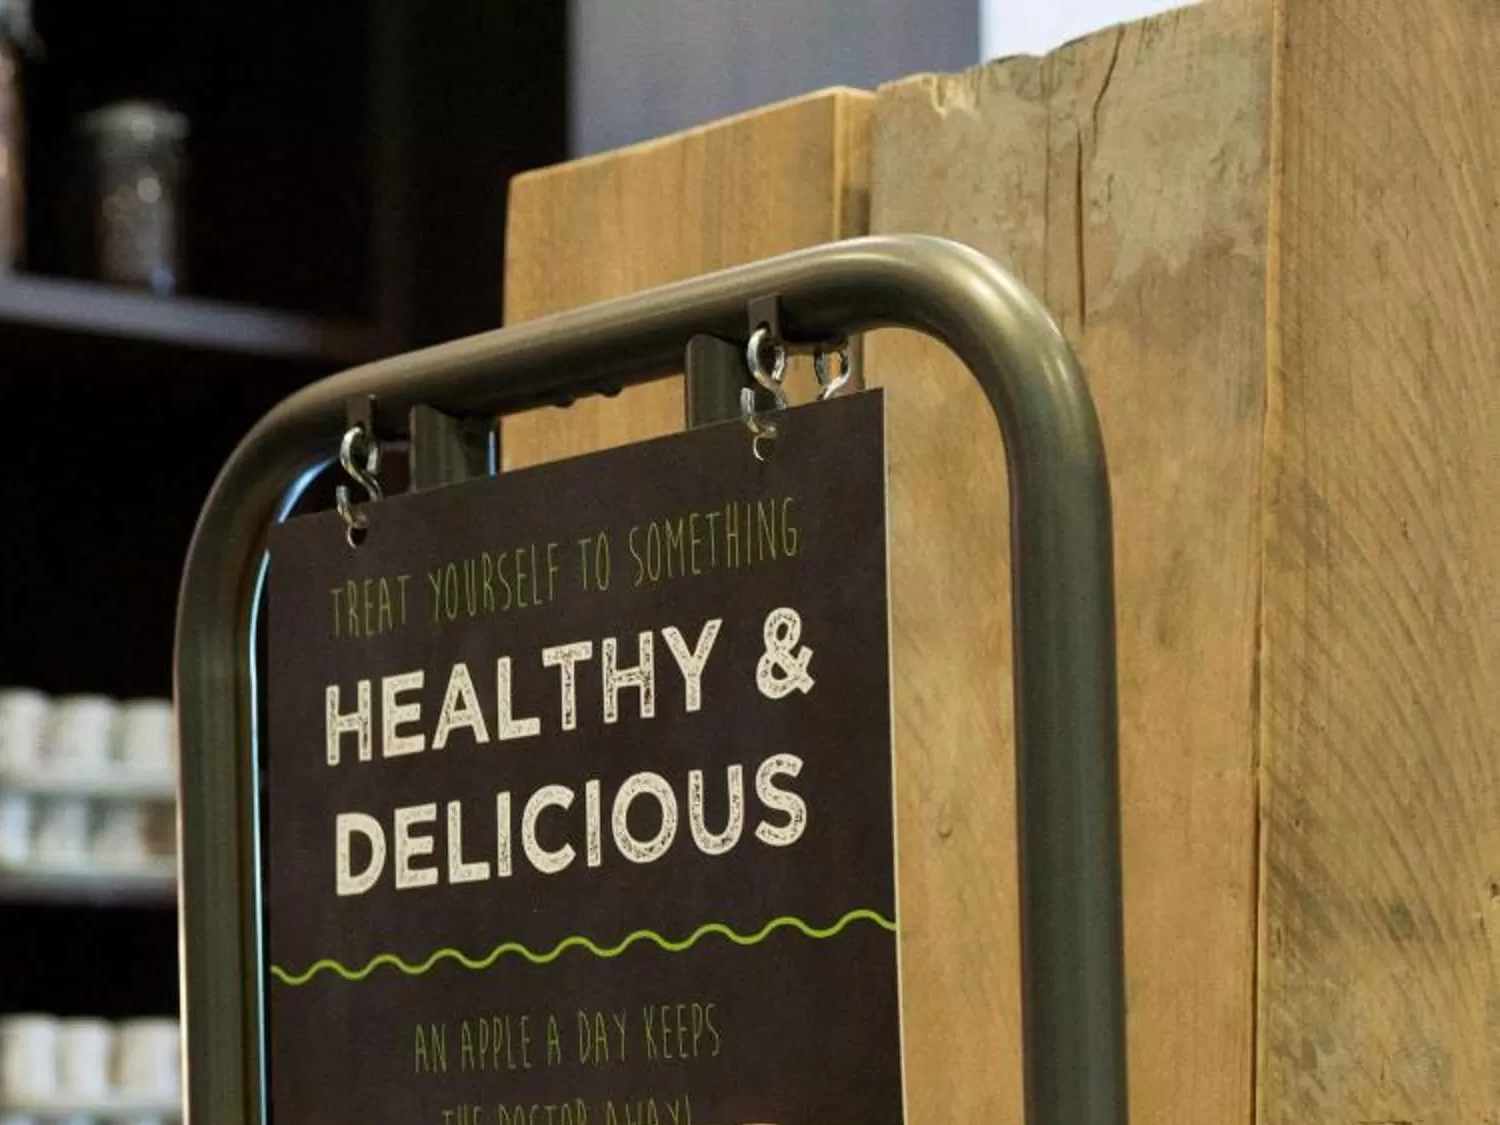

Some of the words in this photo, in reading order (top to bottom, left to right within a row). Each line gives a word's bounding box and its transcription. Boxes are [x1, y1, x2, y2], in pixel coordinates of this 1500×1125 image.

[331, 575, 412, 638] TREAT
[427, 543, 560, 621] YOURSELF
[577, 530, 612, 591] TO
[628, 497, 798, 587] SOMETHING
[325, 618, 723, 765] HEALTHY
[754, 607, 815, 699] &
[335, 753, 808, 896] DELICIOUS
[414, 1023, 447, 1073] AN
[460, 1014, 533, 1072] APPLE
[547, 1014, 561, 1067] A
[577, 1007, 628, 1065] DAY
[642, 1002, 721, 1060] KEEPS
